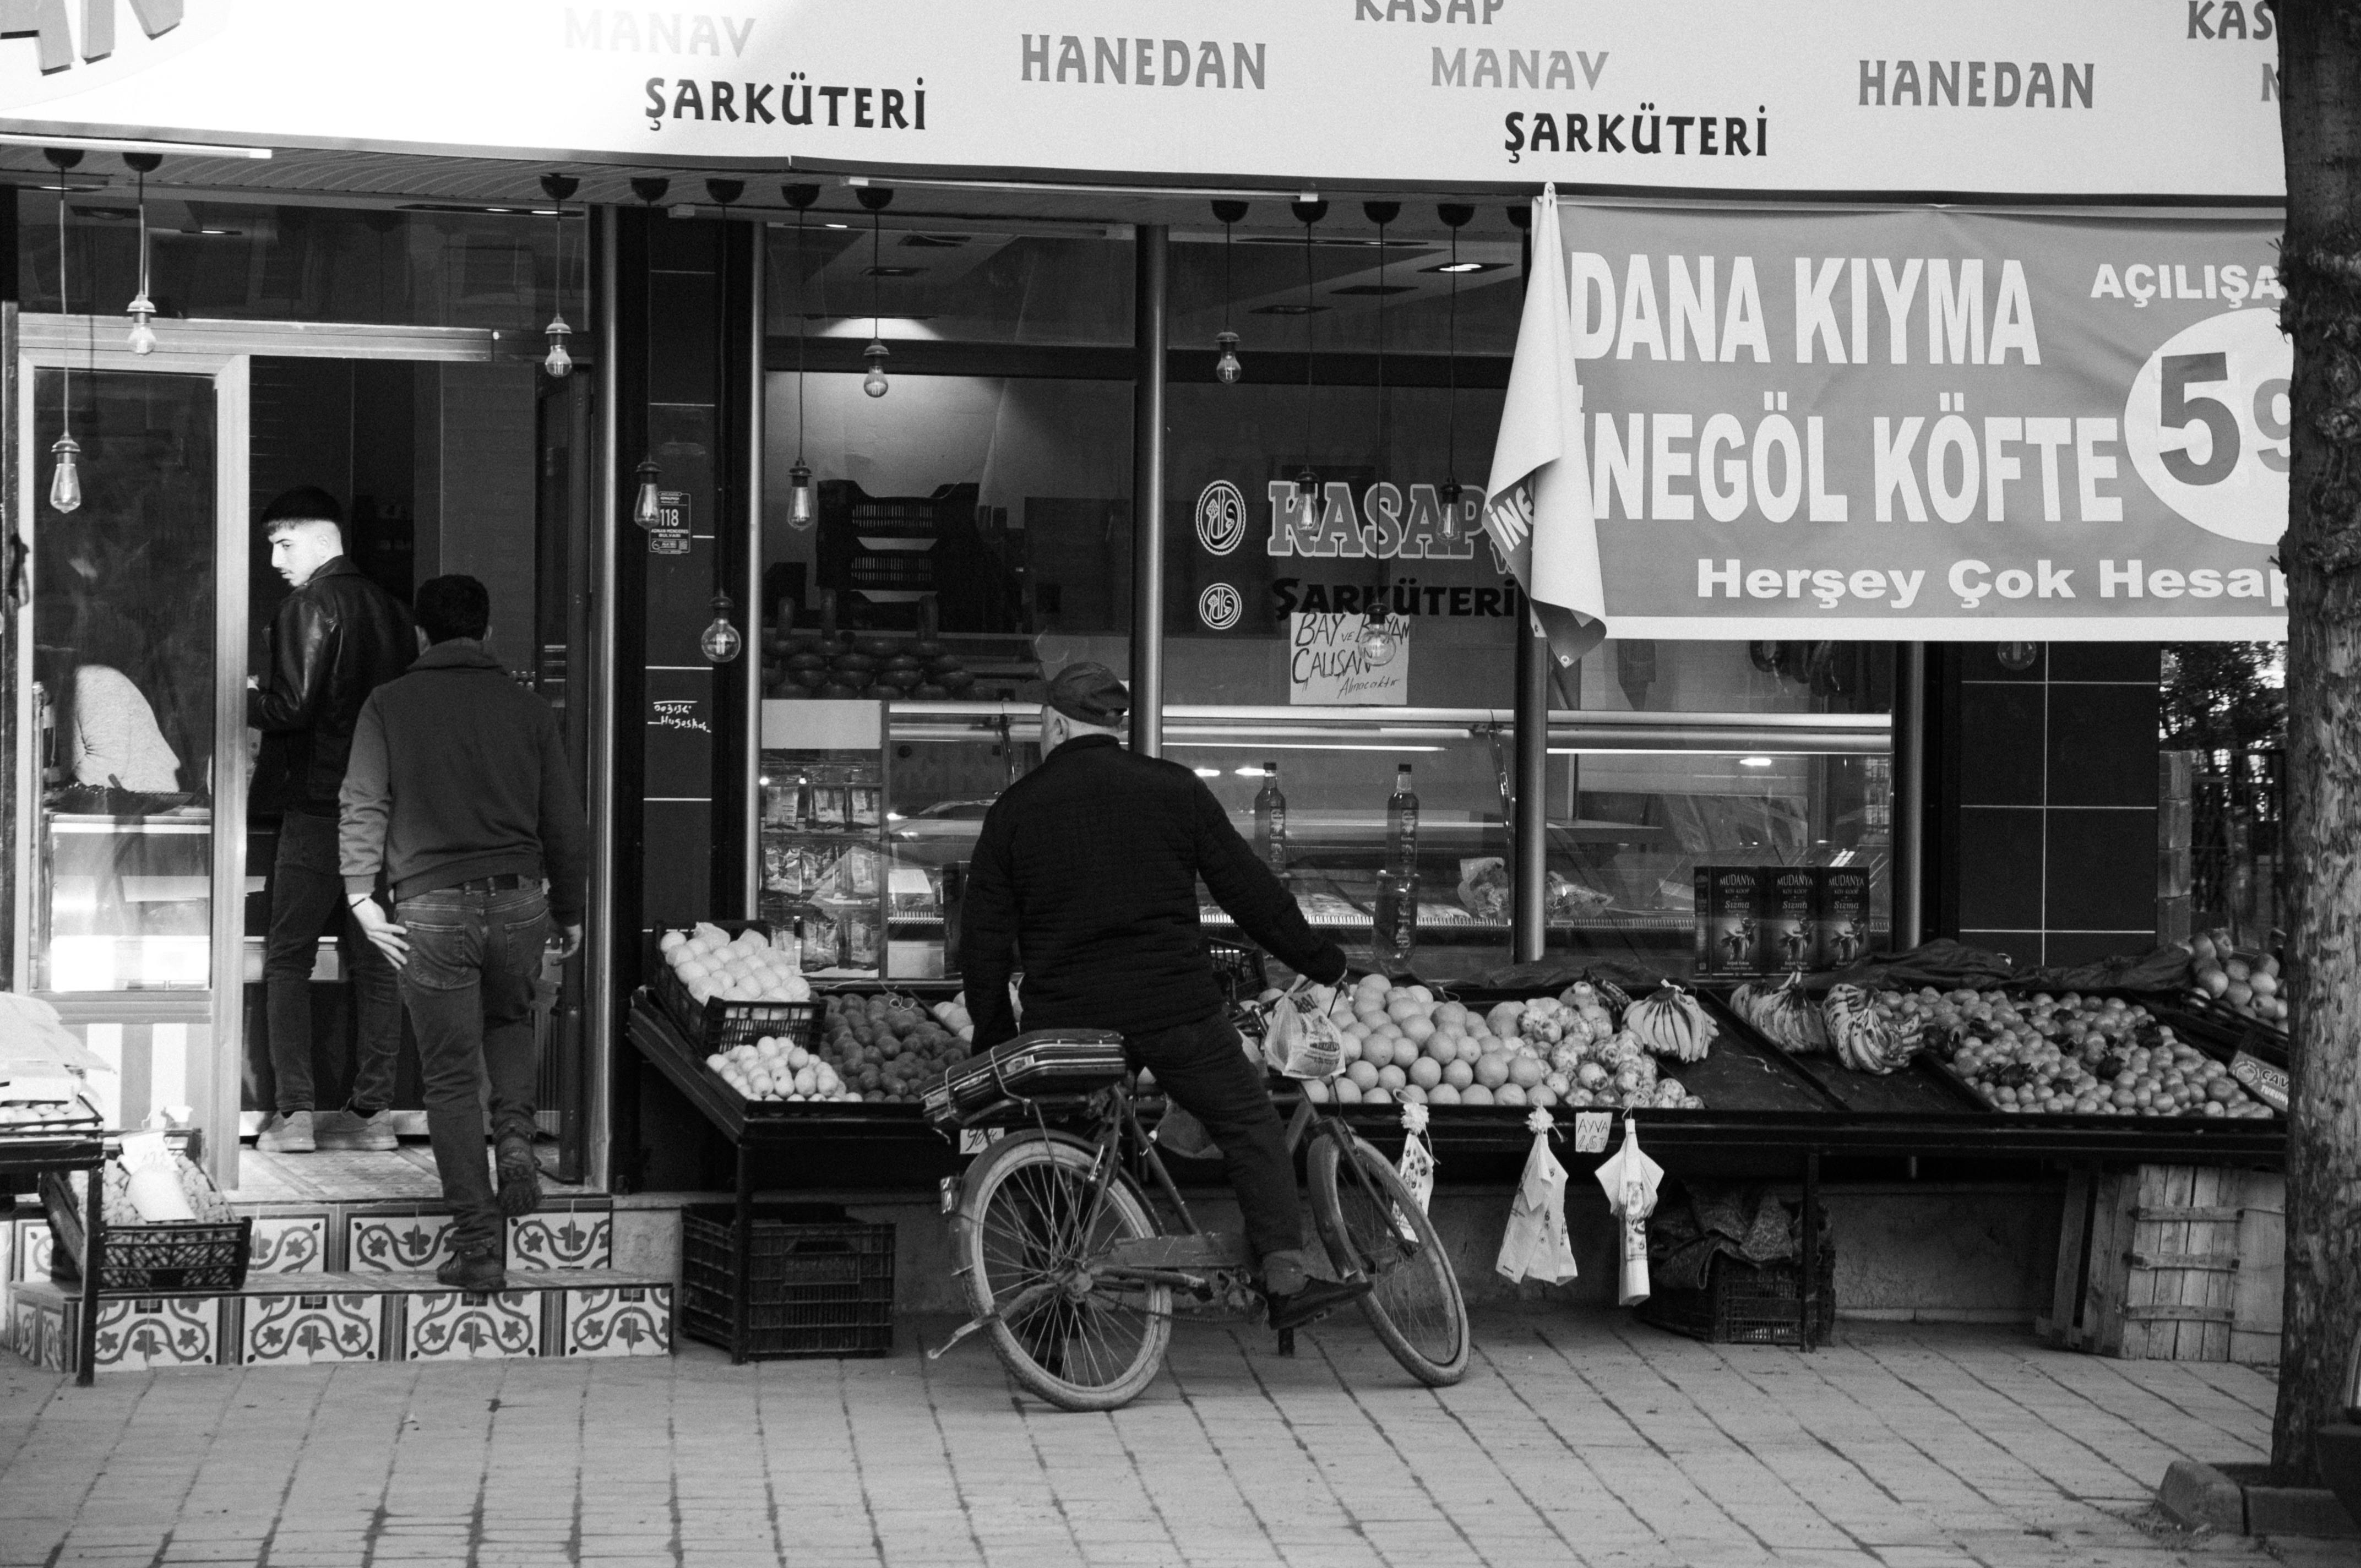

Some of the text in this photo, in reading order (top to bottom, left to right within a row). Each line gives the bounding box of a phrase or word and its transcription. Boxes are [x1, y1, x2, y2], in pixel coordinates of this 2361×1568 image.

[564, 7, 757, 58] MANAV
[1356, 0, 1503, 24] KASAP
[2187, 0, 2273, 40] KAS
[1021, 34, 1265, 89] HANEDAN
[1432, 47, 1609, 90] MANAV
[646, 72, 926, 130] ŞARKÜTERİ
[1859, 60, 2095, 108] HANEDAN
[1505, 103, 1767, 164] ŞARKÜTERİ
[2091, 264, 2286, 307] AÇILIŞA
[1571, 252, 2041, 364] DANA KIYMA
[1581, 385, 2124, 523] NEGÖL KÖFTE
[660, 508, 679, 527] 118
[1267, 480, 1487, 559] KASAP
[1487, 476, 1536, 552] İNE
[1271, 577, 1515, 620] ŞARKÜTERİ
[1698, 559, 1925, 609] Herşey
[1948, 559, 2076, 609] Çok
[1294, 612, 1346, 646] BAY
[1355, 613, 1410, 645] BYAN
[1720, 874, 1755, 886] MUDANYA
[1777, 874, 1813, 886] MUDANYA
[1829, 874, 1864, 886] MUDANYA
[1782, 901, 1807, 909] Sızma
[1834, 901, 1859, 909] Sızma
[1577, 1118, 1608, 1134] AYVA
